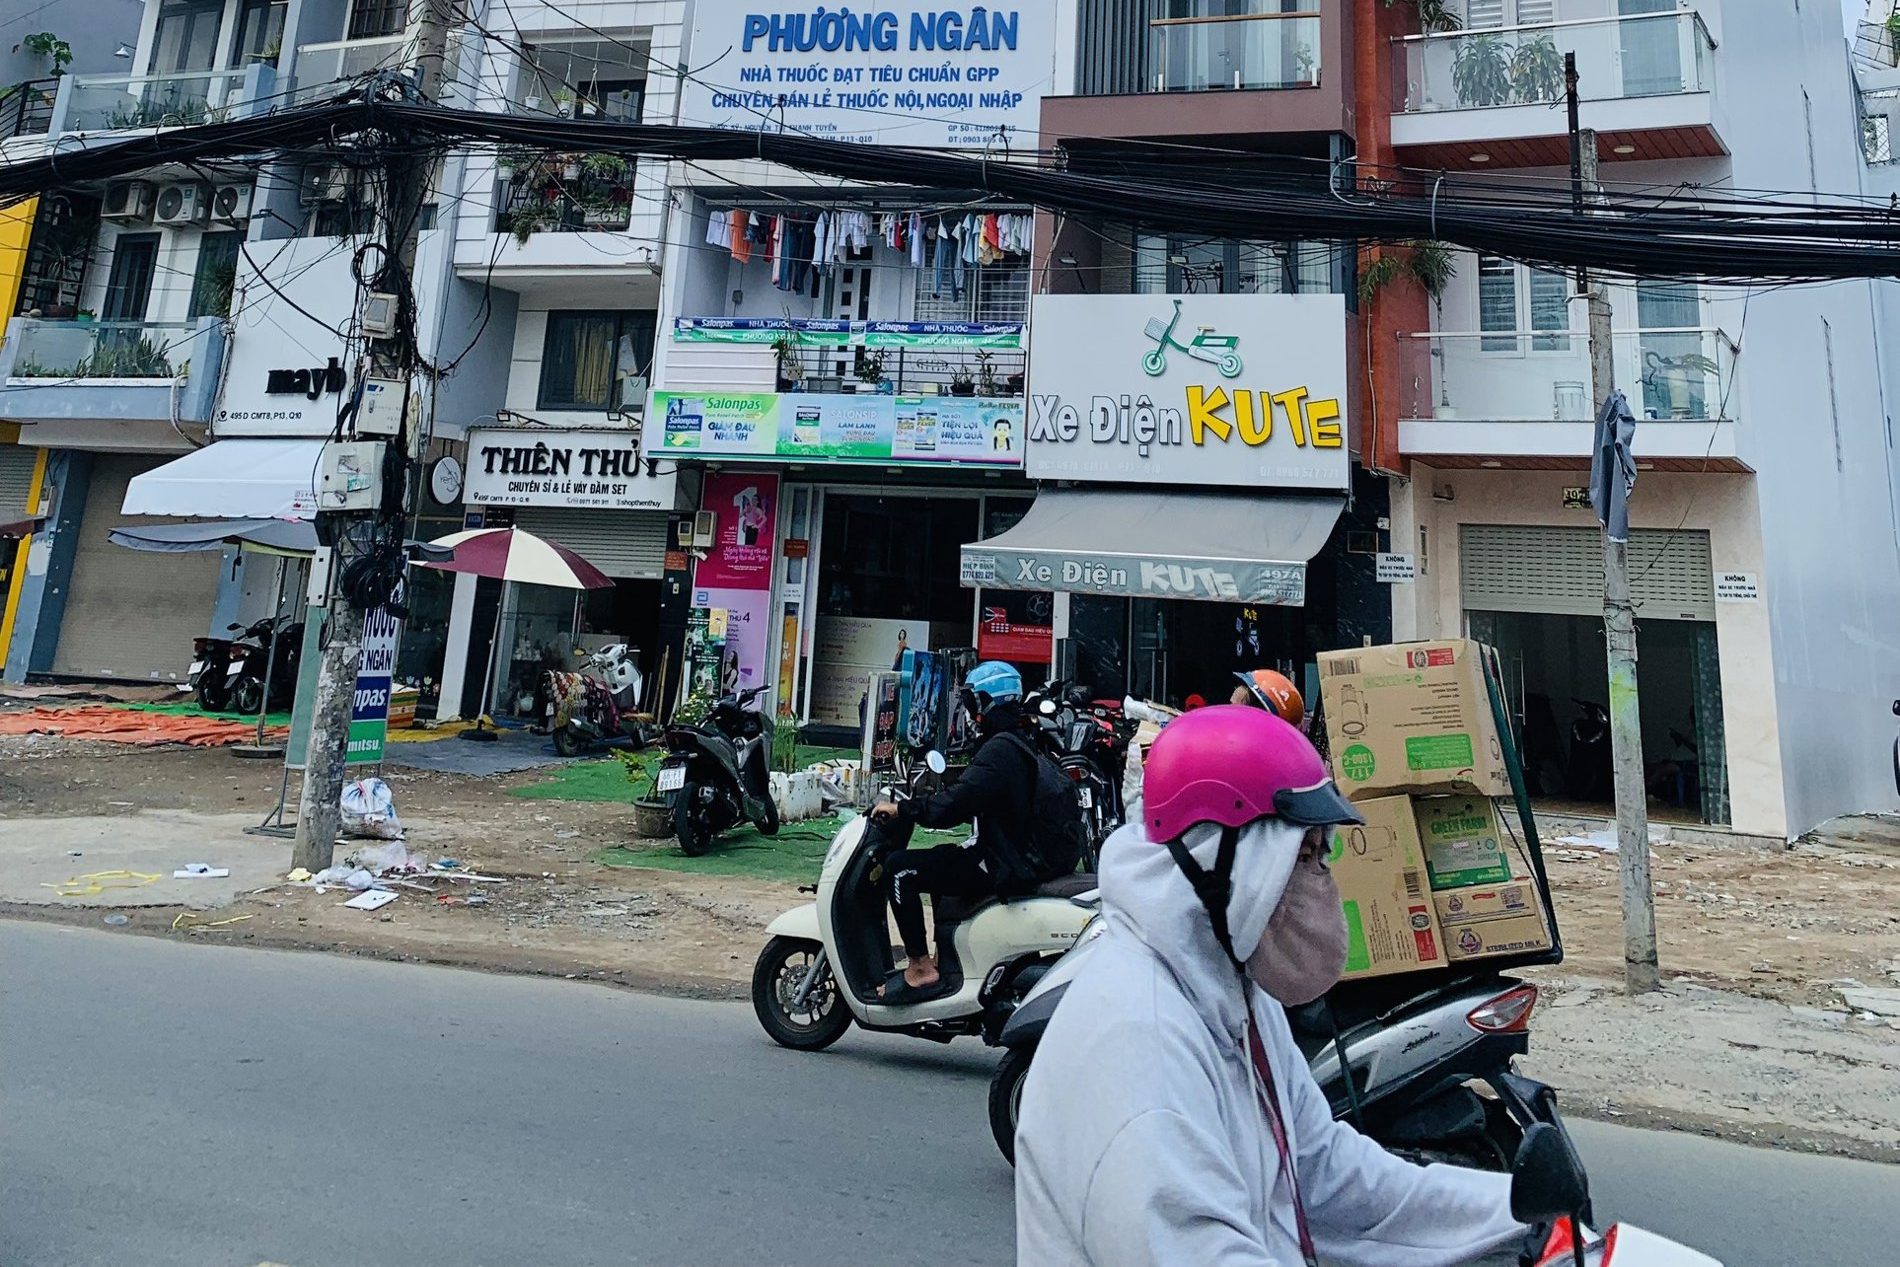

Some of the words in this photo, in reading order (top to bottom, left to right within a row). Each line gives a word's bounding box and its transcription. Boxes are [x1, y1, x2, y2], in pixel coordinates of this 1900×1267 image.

[742, 6, 898, 53] PHƯƠNG
[909, 6, 1019, 51] NGÂN
[740, 65, 772, 83] NHÀ
[777, 63, 828, 82] THUỐC
[833, 67, 864, 85] ĐẠT
[869, 65, 903, 82] TIÊU
[908, 61, 961, 82] CHUẨN
[966, 67, 999, 82] GPP
[711, 90, 779, 108] CHUYÊN
[780, 89, 811, 108] BÁN
[813, 88, 833, 108] LẺ
[836, 89, 889, 108] THUỐC
[979, 89, 1023, 111] NHẬP
[923, 324, 940, 332] NHÀ
[942, 324, 968, 333] THUỐC
[706, 397, 761, 411] Salonpas
[289, 411, 302, 421] Q10
[668, 416, 700, 425] Salonpas
[1031, 394, 1080, 443] Xe
[1089, 394, 1182, 457] Điện
[1185, 385, 1344, 448] KUTE
[735, 423, 756, 432] ĐAU
[714, 431, 748, 441] NHANH
[480, 441, 573, 476] THIÊN
[508, 480, 540, 493] CHUYÊN
[542, 479, 552, 494] SỈ
[552, 482, 559, 494] &
[561, 479, 571, 494] LẺ
[573, 481, 587, 495] VÁY
[589, 480, 609, 495] ĐẦM
[611, 484, 628, 496] SET
[1016, 558, 1053, 584] Xe
[1062, 560, 1128, 590] Điện
[1140, 561, 1240, 599] KUTE
[1261, 569, 1302, 581] 497A
[1724, 574, 1746, 582] KHÔNG
[365, 644, 393, 671] NGÂN
